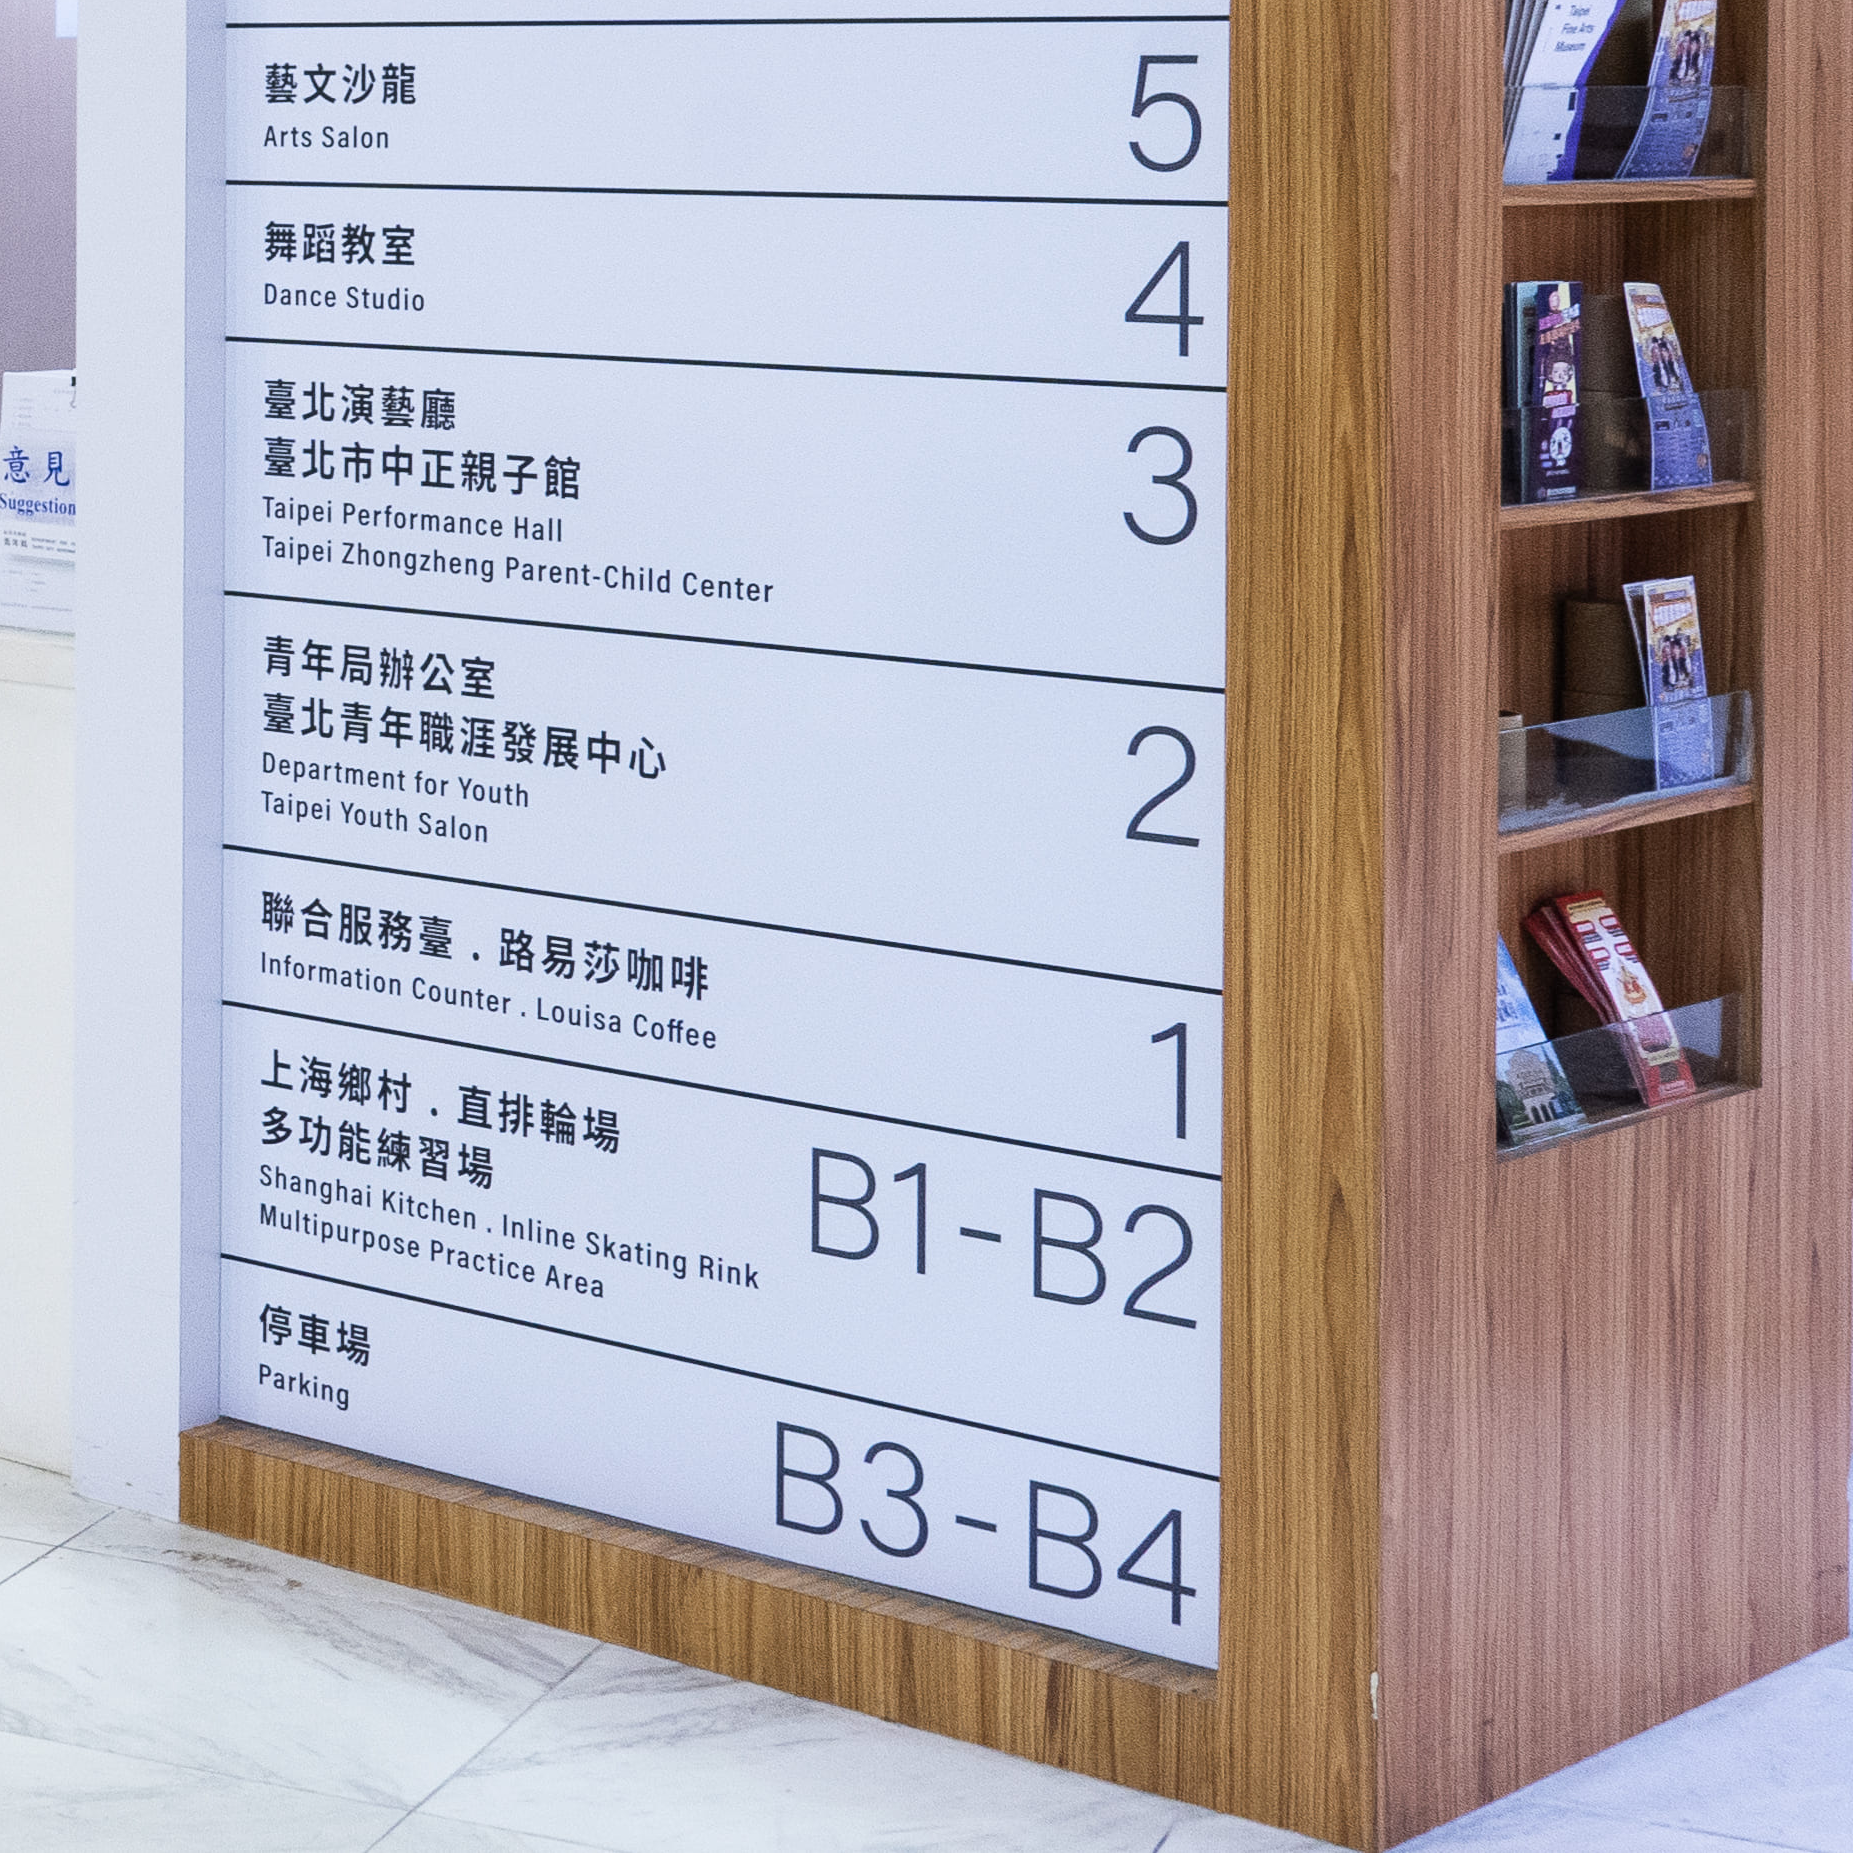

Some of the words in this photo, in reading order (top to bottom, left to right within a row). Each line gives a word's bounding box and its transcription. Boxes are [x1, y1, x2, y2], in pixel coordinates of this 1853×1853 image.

[265, 63, 416, 104] 藝文沙龍
[1129, 55, 1202, 172] 5
[264, 126, 312, 147] Arts
[322, 126, 388, 148] Salon
[265, 221, 415, 265] 舞蹈教室
[265, 283, 336, 307] Dance
[347, 286, 424, 311] Studio
[1125, 241, 1204, 357] 4
[265, 379, 455, 430] 臺北演藝廳
[265, 436, 580, 500] 臺北市中正親子館
[1123, 426, 1198, 545] 3
[263, 496, 331, 526] Taipei
[343, 503, 503, 537] Performance
[515, 516, 561, 542] Hall
[262, 535, 331, 565] Taipei
[342, 542, 493, 583] Zhongzheng
[506, 557, 670, 593] Parent-Child
[683, 572, 773, 602] Center
[264, 635, 495, 699] 青年局辦公室
[264, 693, 666, 779] 臺北青年職涯發展中心
[263, 752, 405, 791] Department
[415, 771, 448, 796] for
[458, 777, 528, 807] Youth
[1126, 726, 1200, 847] 2
[261, 791, 330, 822] Taipei
[341, 802, 407, 831] Youth
[419, 812, 487, 842] Salon
[262, 952, 401, 996] Information
[412, 977, 511, 1014] Counter
[537, 998, 621, 1033] Louisa
[633, 1014, 716, 1049] Coffee
[1151, 1022, 1187, 1139] 1
[262, 1106, 493, 1189] 多功能練習場
[260, 1164, 370, 1207] Shanghai
[383, 1189, 475, 1229] Kitchen
[503, 1214, 575, 1250] Inline
[586, 1232, 686, 1279] Skating
[700, 1255, 758, 1289] Rink
[260, 1203, 419, 1258] Multipurpose
[431, 1240, 535, 1283] Practice
[545, 1265, 603, 1298] Area
[259, 1304, 370, 1366] 停車場
[259, 1364, 349, 1411] Parking
